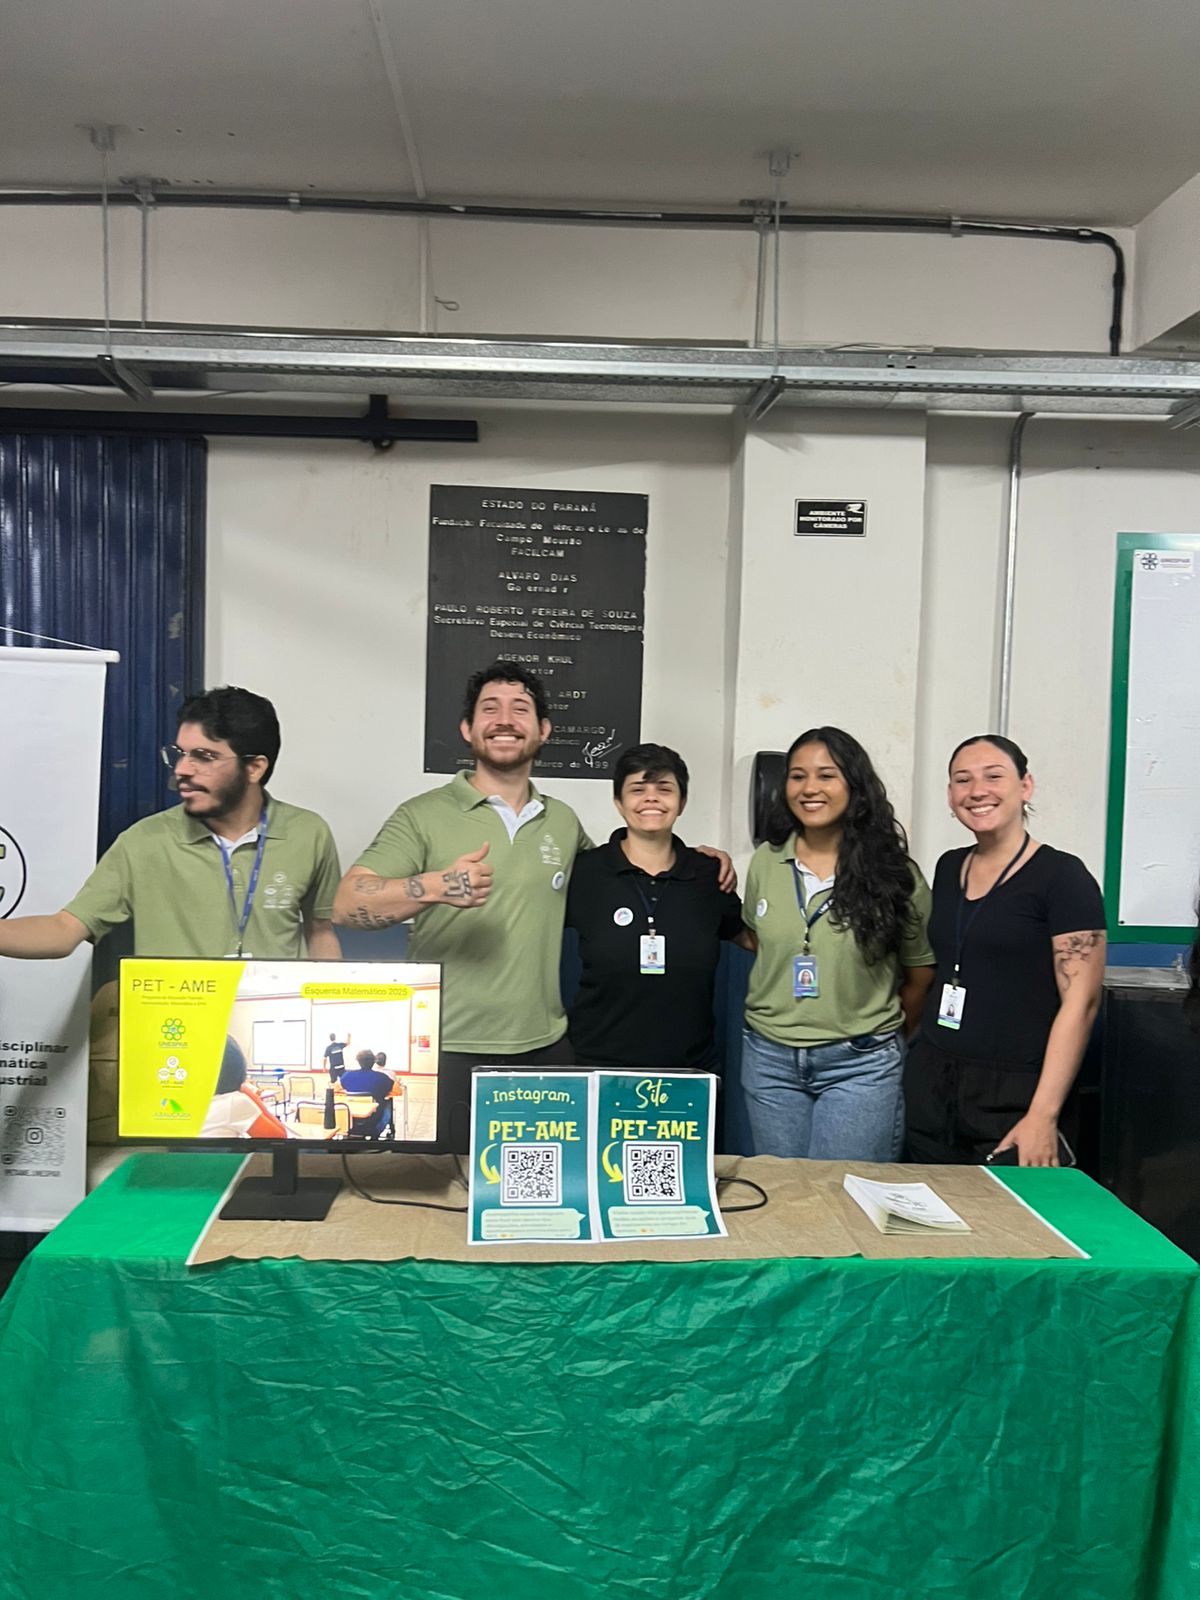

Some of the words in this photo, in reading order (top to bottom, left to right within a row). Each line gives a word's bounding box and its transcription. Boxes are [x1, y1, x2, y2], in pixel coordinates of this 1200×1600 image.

[481, 500, 524, 509] ESTADO
[531, 502, 546, 511] DO
[553, 502, 597, 513] PARANÁ
[550, 573, 578, 583] DIAS
[434, 603, 468, 613] PAULO
[475, 604, 524, 616] ROBERTO
[581, 609, 595, 618] DE
[602, 610, 638, 619] SOUZA
[497, 653, 540, 664] AGENOR
[552, 725, 606, 735] CAMARGO
[131, 978, 165, 992] PET
[179, 979, 217, 993] AME
[493, 1088, 570, 1104] Instagram
[635, 1078, 673, 1109] Site
[489, 1120, 580, 1141] PET-AME
[611, 1118, 701, 1140] PET-AME
